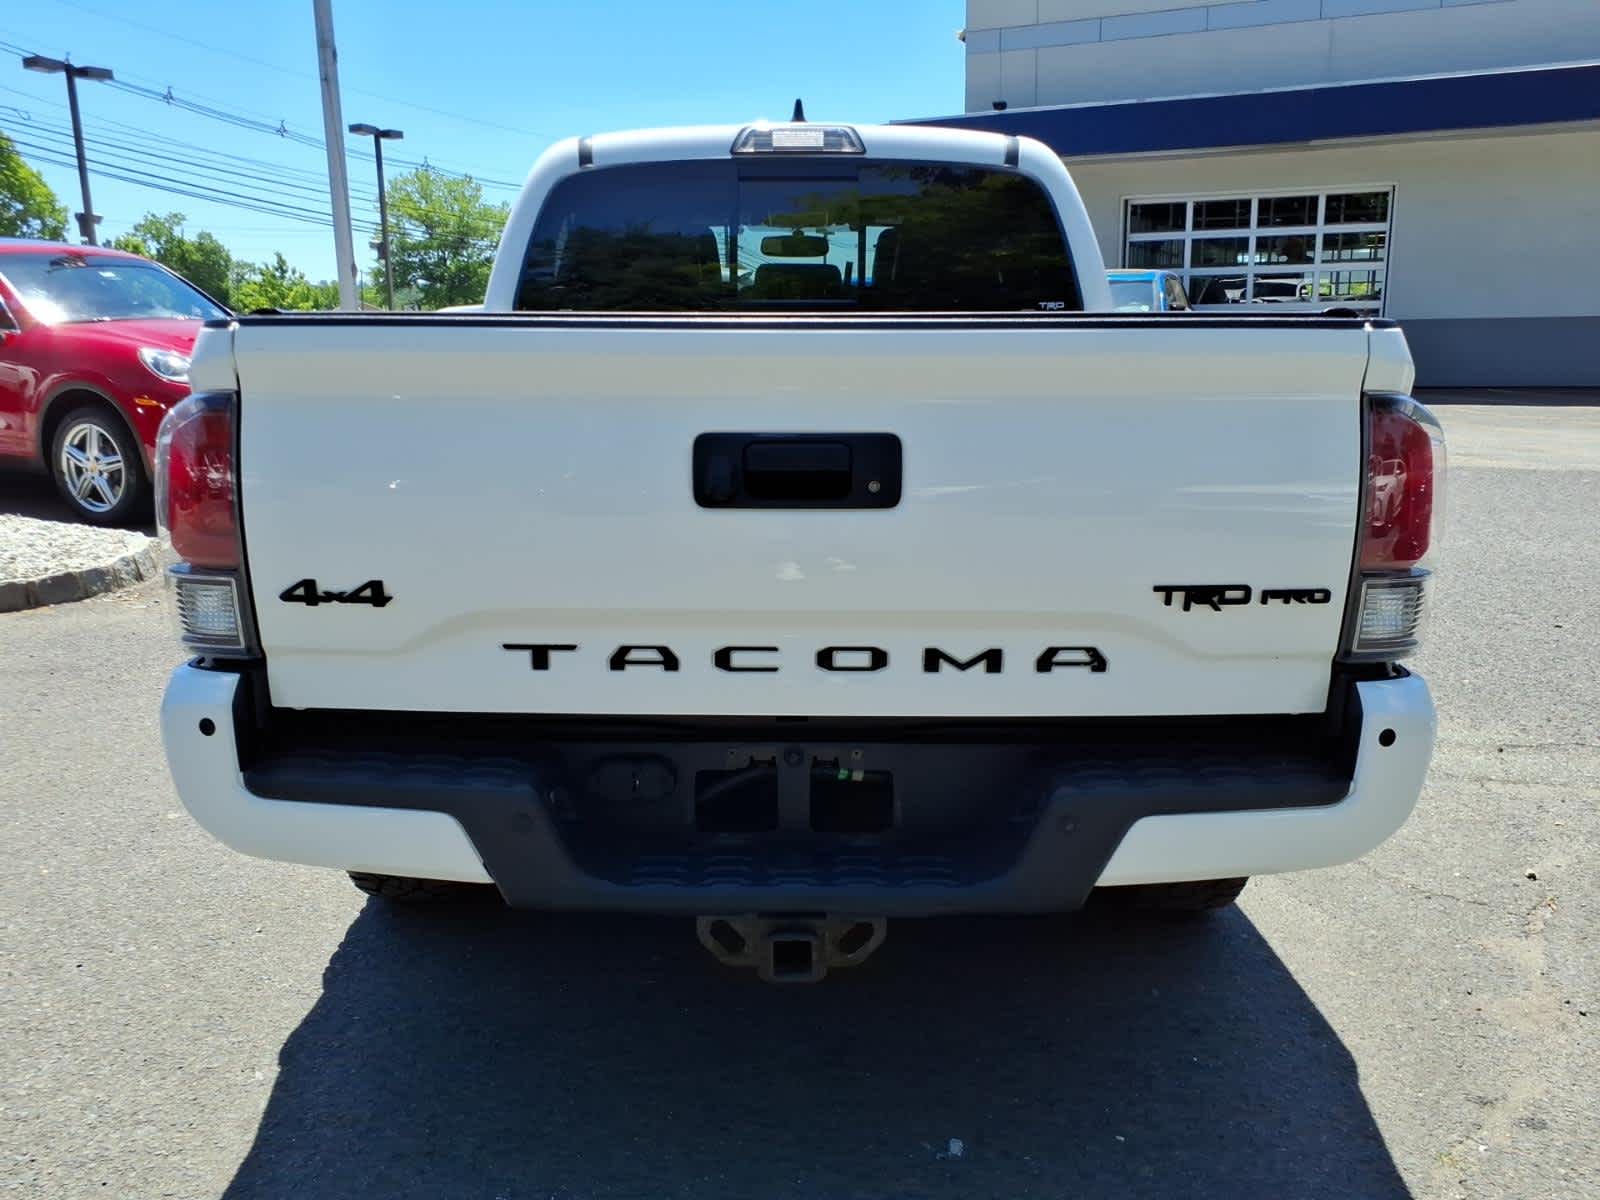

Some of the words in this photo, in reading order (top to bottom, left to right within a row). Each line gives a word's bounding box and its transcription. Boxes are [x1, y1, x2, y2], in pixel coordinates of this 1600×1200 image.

[1039, 301, 1065, 311] TRD
[279, 579, 393, 608] 4x4
[1153, 585, 1252, 612] TRD
[1260, 588, 1332, 606] PRO
[501, 643, 1109, 673] TACOMA
